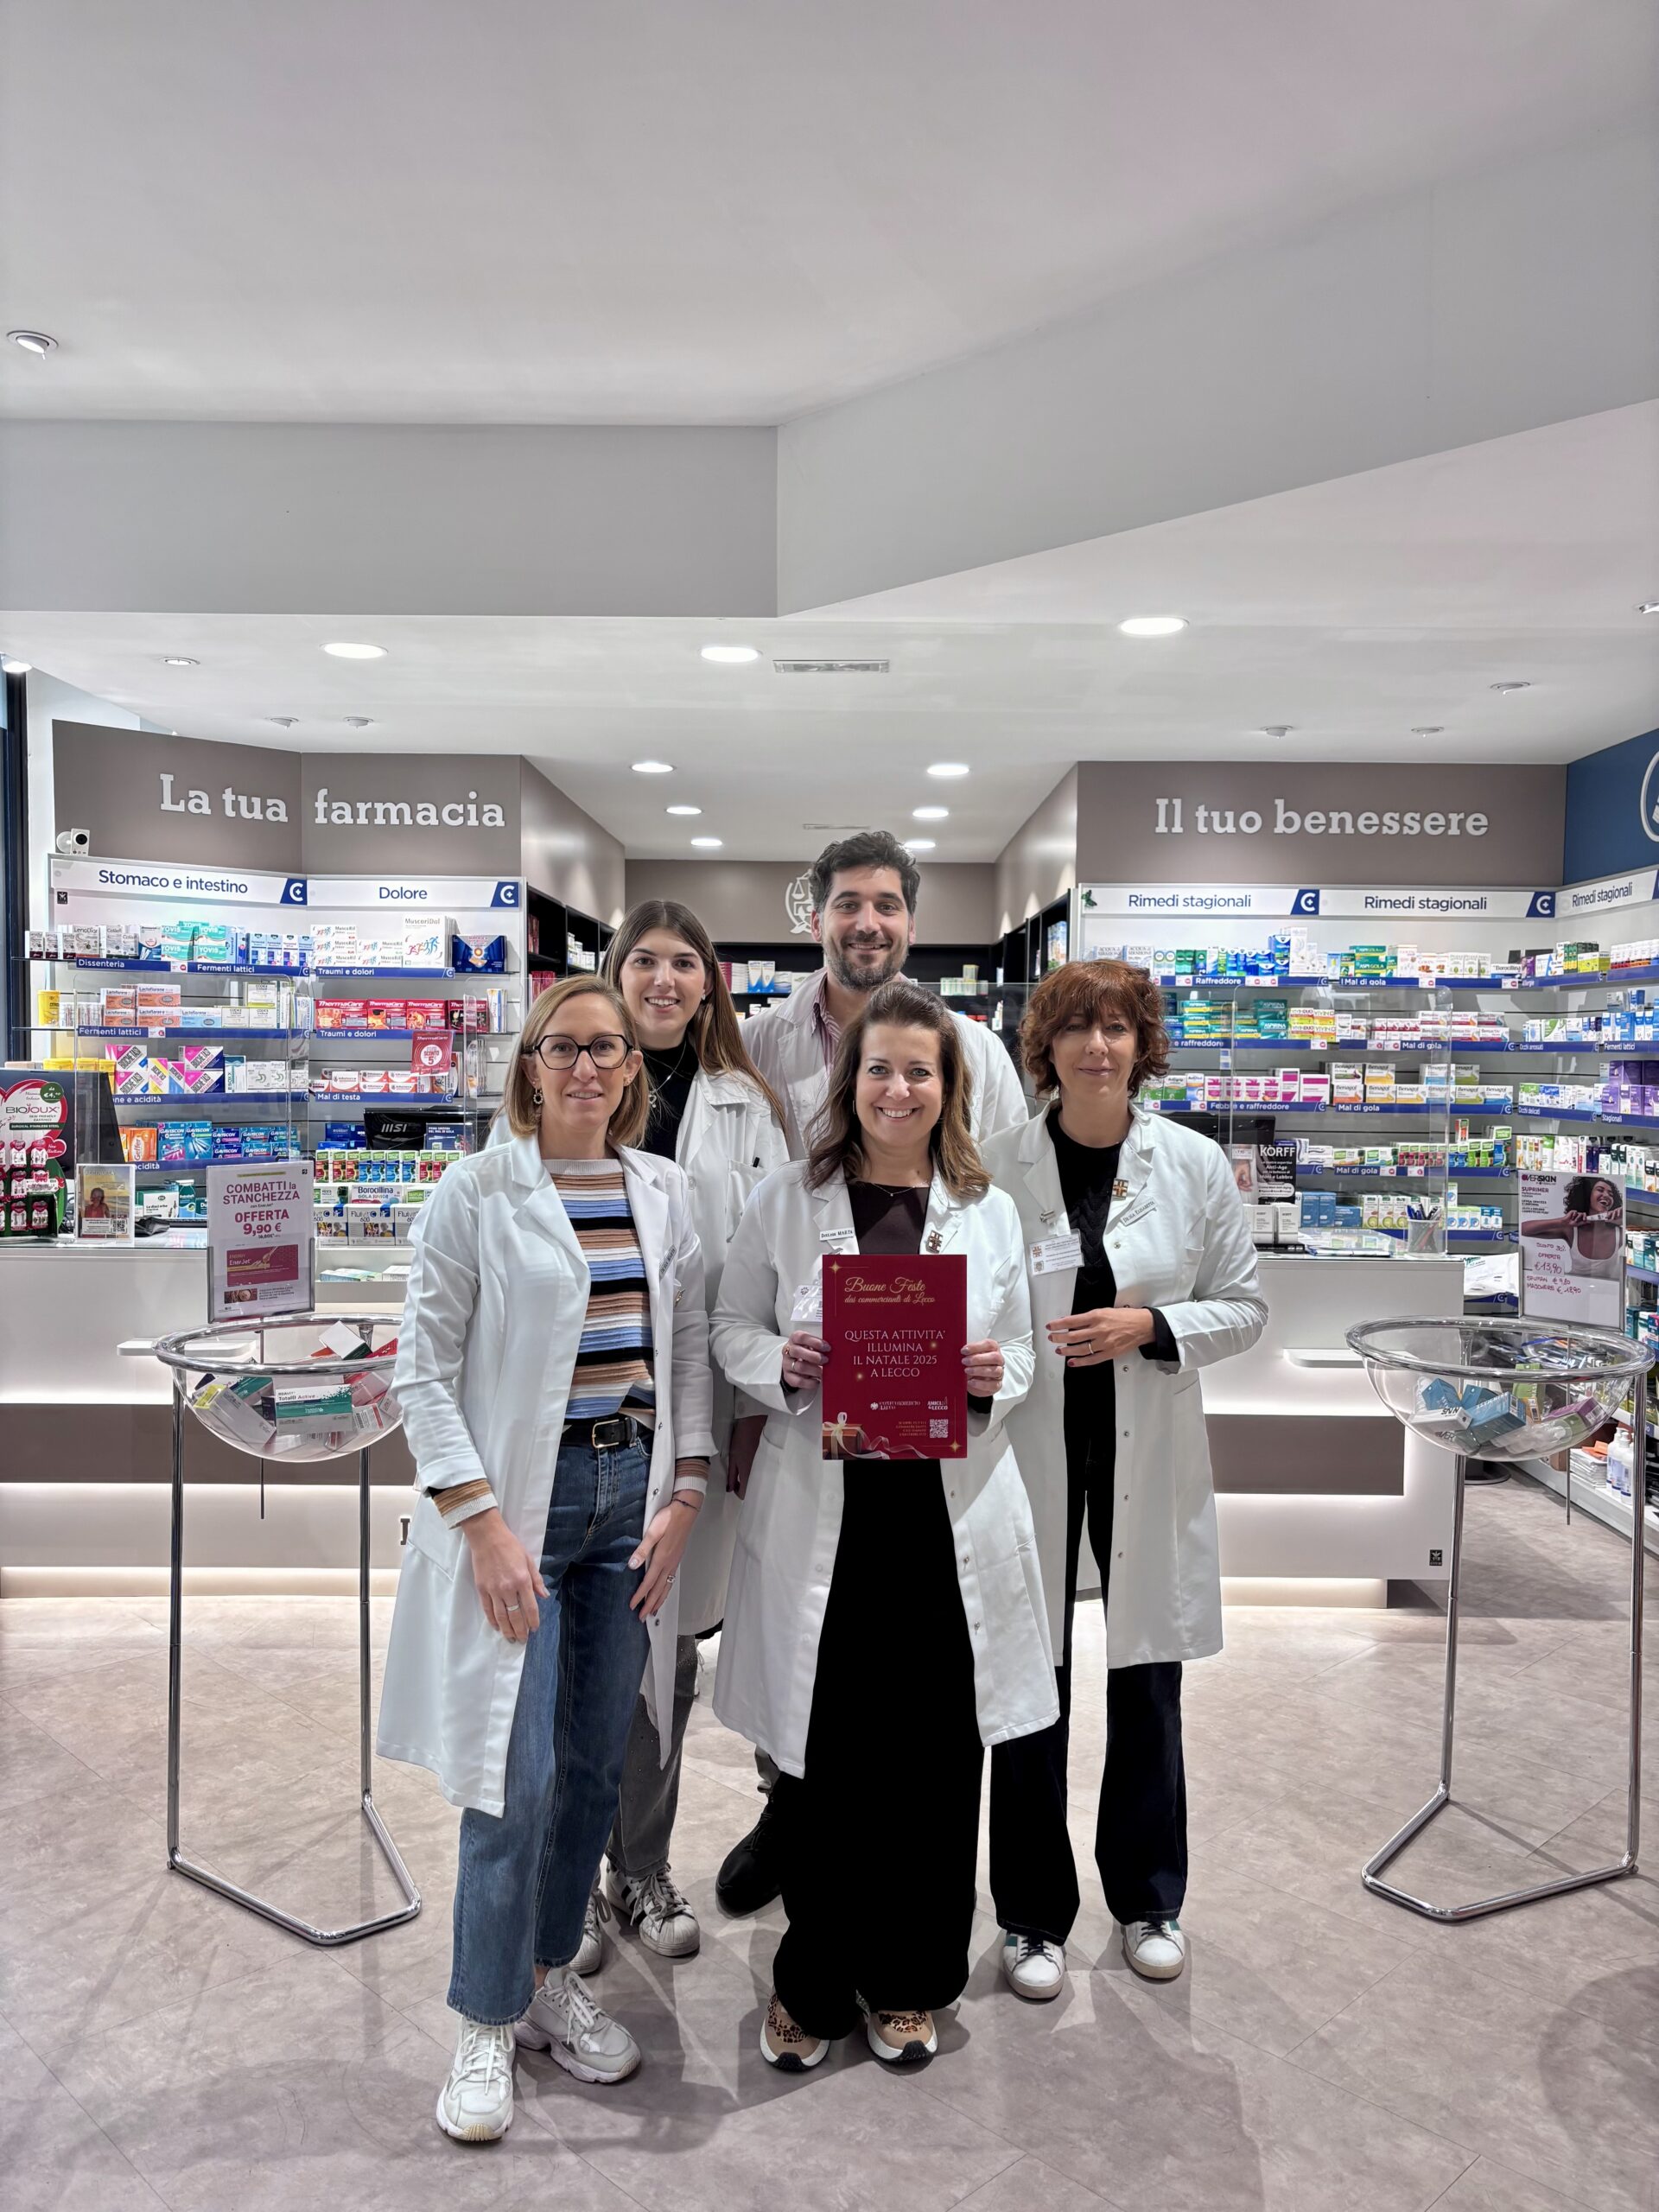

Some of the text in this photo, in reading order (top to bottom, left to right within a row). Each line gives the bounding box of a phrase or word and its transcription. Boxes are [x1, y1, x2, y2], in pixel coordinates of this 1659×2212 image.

[159, 773, 506, 827] La tua farmacia
[1154, 798, 1489, 836] Il tuo benessere
[99, 869, 248, 894] Stomaco e intestino
[378, 887, 428, 900] Dolore
[1572, 881, 1633, 907] Rimedi stagionali
[1128, 893, 1251, 911] Rimedi stagionali
[1364, 895, 1488, 912] Rimedi stagionali
[79, 958, 125, 969] Dissenteria
[197, 963, 255, 974] Fermenti lattici
[79, 1027, 142, 1036] Fermenti lattici
[1427, 1042, 1442, 1051] gola
[1605, 1042, 1636, 1051] Fermenti lattici
[1602, 1114, 1623, 1123] Stagionali
[1261, 1147, 1296, 1157] KORFF
[226, 1180, 287, 1194] COMBATTI
[223, 1191, 300, 1205] STANCHEZZA
[234, 1209, 289, 1223] OFFERTA
[243, 1223, 282, 1236] 9,90 €
[844, 1276, 926, 1294] Buone Feste
[857, 1294, 901, 1304] commercianti
[903, 1294, 912, 1304] di
[912, 1292, 935, 1306] Lecco
[844, 1329, 946, 1342] QUESTA ATTIVITA'
[867, 1342, 924, 1352] ILLUMINA
[854, 1355, 938, 1365] IL NATALE 2025
[870, 1368, 920, 1377] A LECCO
